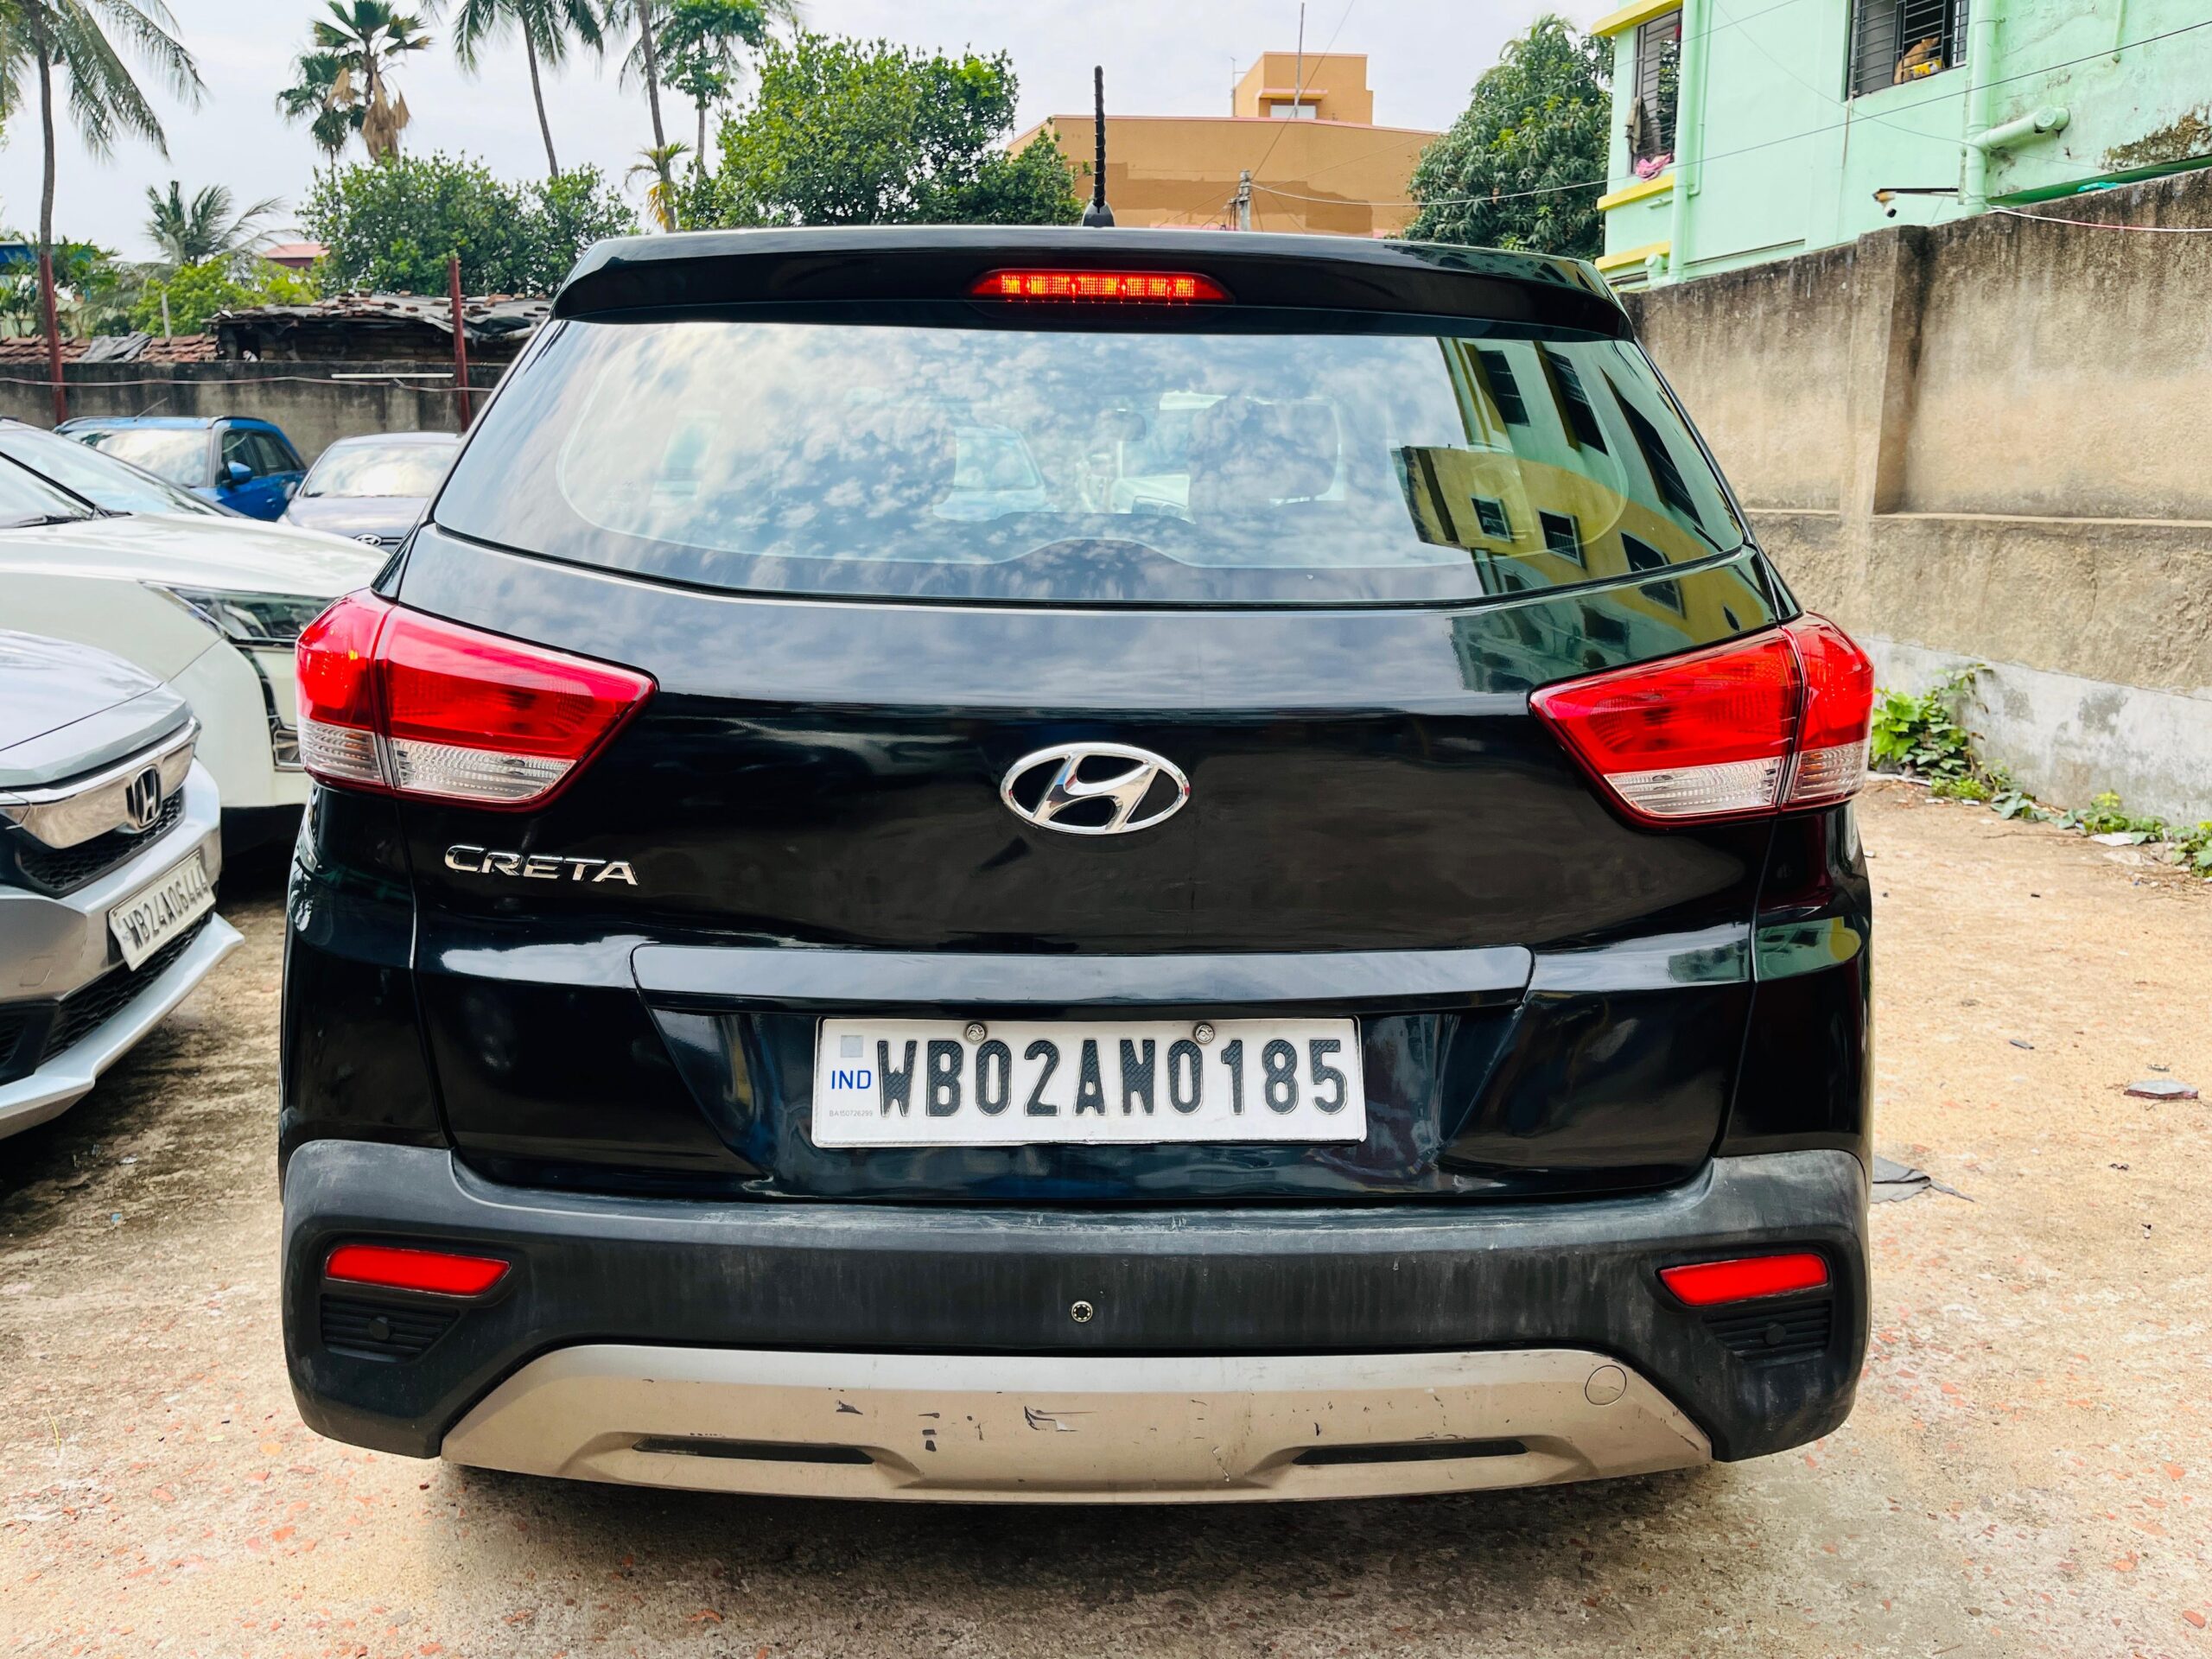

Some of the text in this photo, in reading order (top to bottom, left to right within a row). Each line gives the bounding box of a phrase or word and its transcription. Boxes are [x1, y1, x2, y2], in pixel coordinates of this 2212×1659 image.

[444, 843, 639, 886] CRETA
[831, 1070, 872, 1090] IND
[876, 1039, 1348, 1117] WB02AN0185
